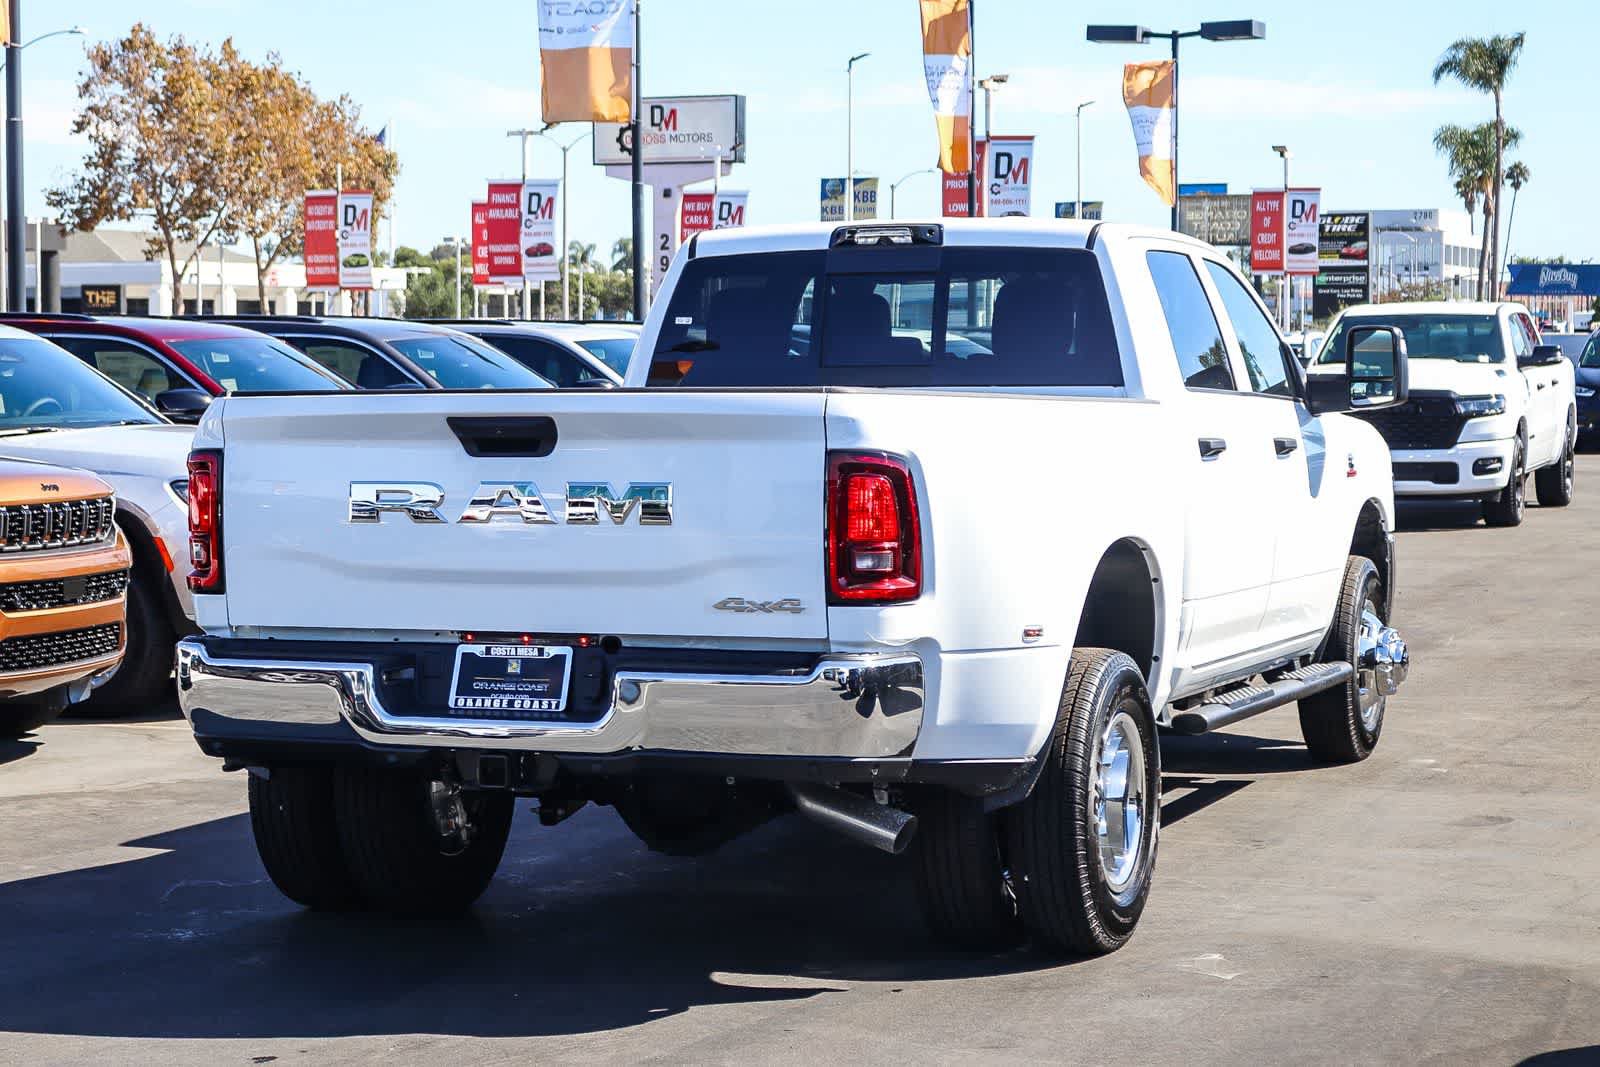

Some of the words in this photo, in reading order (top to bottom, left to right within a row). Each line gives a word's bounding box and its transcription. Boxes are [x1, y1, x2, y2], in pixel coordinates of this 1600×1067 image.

[669, 132, 713, 143] MOTORS
[995, 152, 1029, 185] DM
[492, 193, 517, 204] FINANCE
[853, 191, 877, 203] KBB
[684, 201, 696, 211] WE
[697, 201, 711, 211] BUY
[1256, 200, 1266, 212] ALL
[1267, 200, 1280, 212] TYPE
[488, 208, 520, 219] AVAILABLE
[685, 215, 703, 224] CARS
[1263, 216, 1272, 228] OF
[1323, 224, 1358, 233] TIRE
[1257, 232, 1277, 244] CREDIT
[1254, 249, 1281, 261] WELCOME
[85, 290, 117, 304] THE
[349, 481, 674, 526] RAM
[490, 646, 516, 656] COSTA
[516, 647, 539, 657] MESA
[473, 681, 517, 691] ORANGE
[517, 682, 550, 691] COAST
[456, 698, 509, 708] ORANGE
[514, 699, 558, 710] COAST
